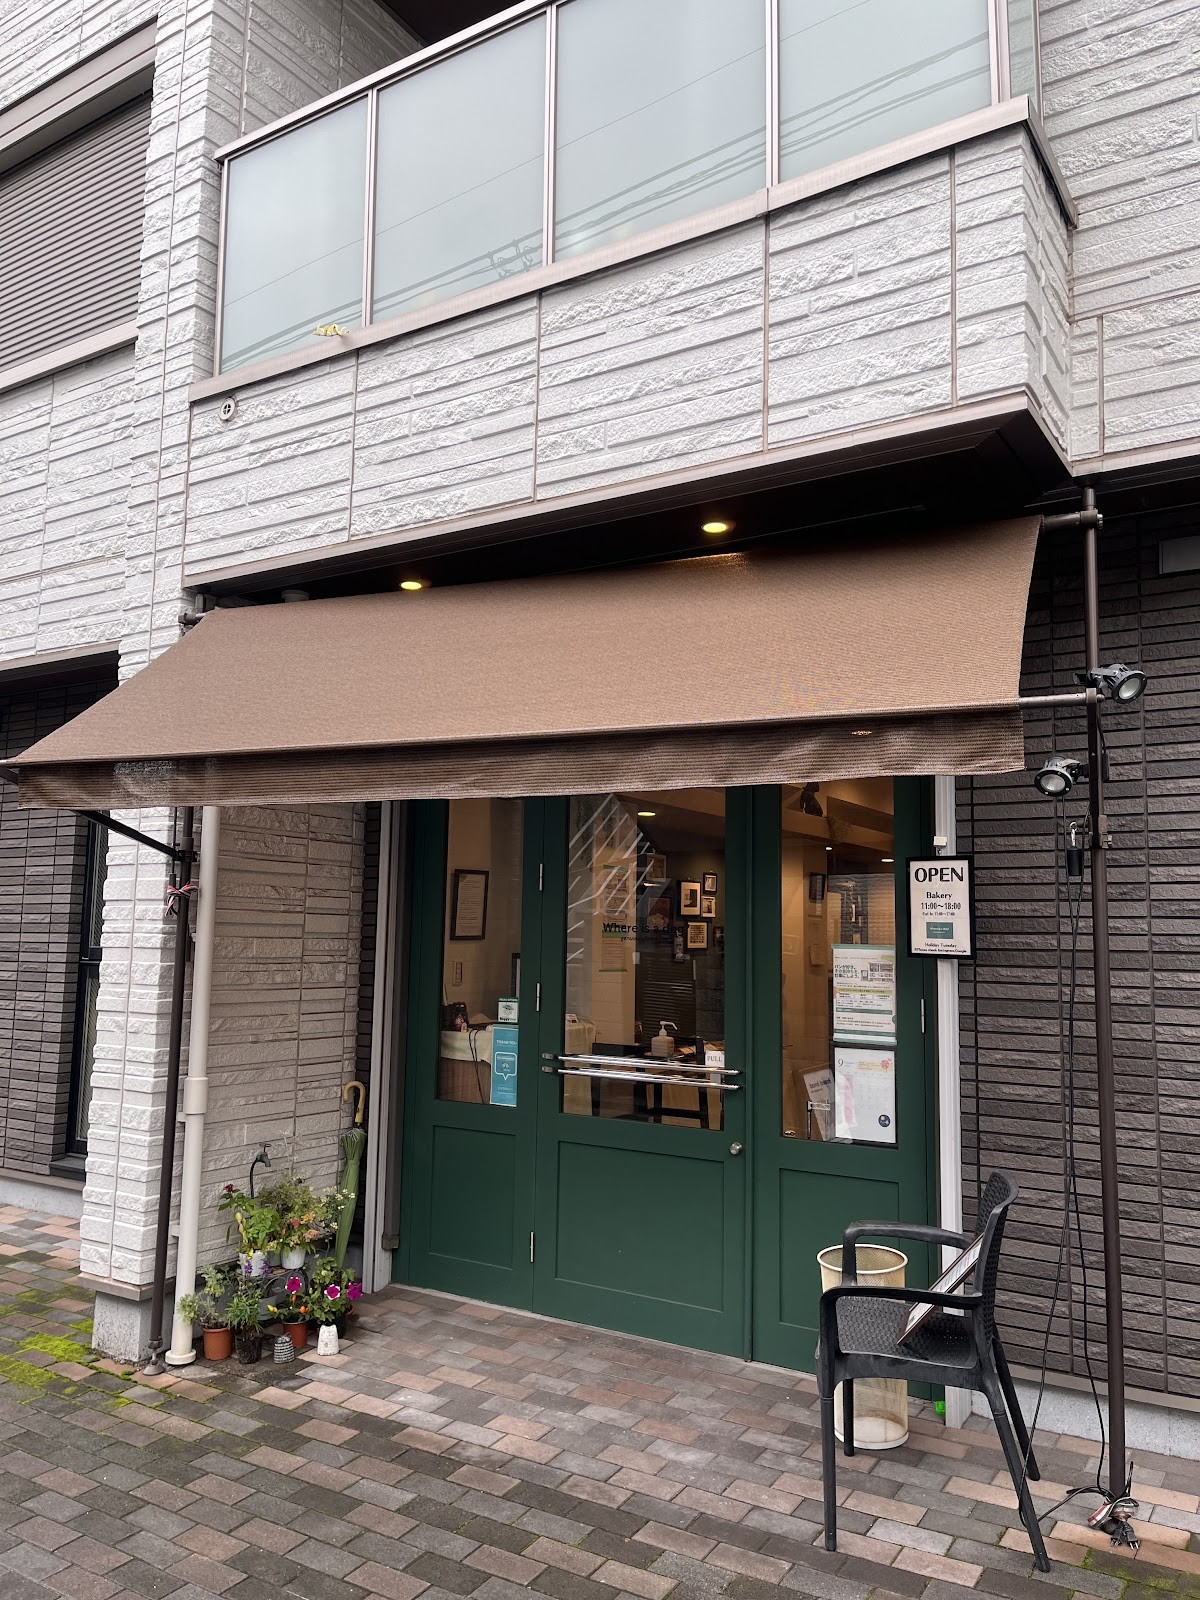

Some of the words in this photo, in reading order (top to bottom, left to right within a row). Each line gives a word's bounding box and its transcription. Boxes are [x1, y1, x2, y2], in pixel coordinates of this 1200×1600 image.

[914, 867, 964, 882] OPEN
[926, 891, 953, 900] Bakery
[602, 922, 638, 933] Where
[641, 923, 650, 933] is
[707, 1055, 723, 1063] PULL
[837, 1058, 844, 1067] 9
